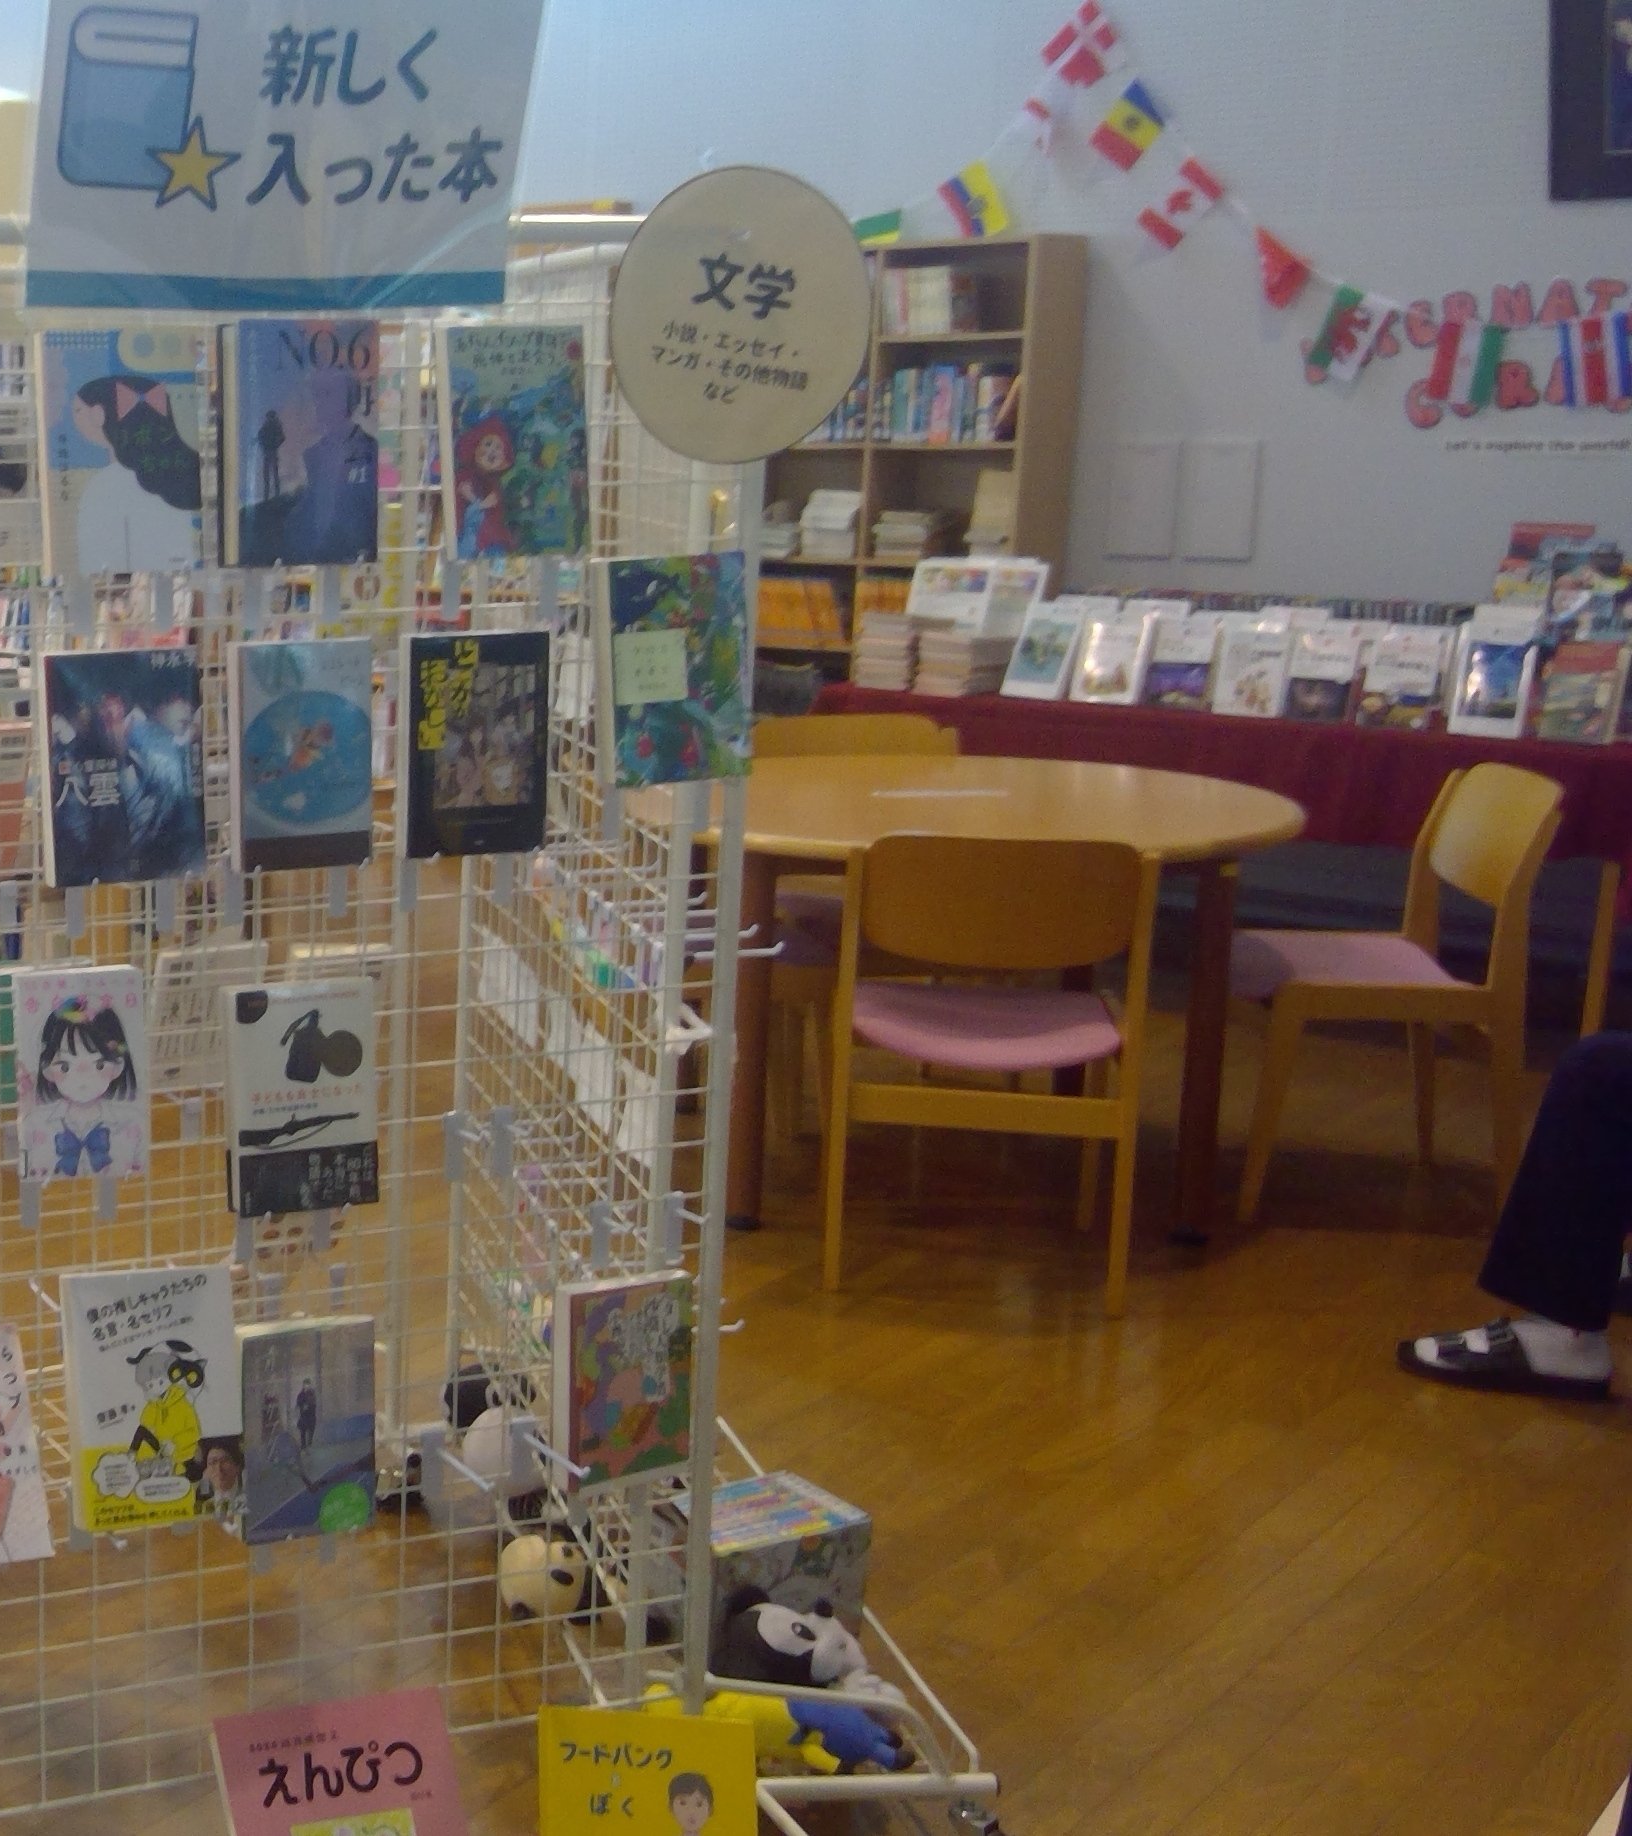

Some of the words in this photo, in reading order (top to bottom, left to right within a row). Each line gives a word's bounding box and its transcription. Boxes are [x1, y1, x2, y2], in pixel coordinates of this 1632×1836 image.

[261, 23, 439, 107] 新しく
[245, 125, 505, 206] 入った本
[691, 252, 797, 320] 文学
[277, 327, 372, 371] NO.6
[662, 320, 799, 359] 小説・エッセイ・
[652, 345, 809, 391] マンガ・その他物語
[702, 380, 739, 405] など
[55, 771, 121, 808] 八雲
[258, 1739, 423, 1808] えんぴつ
[559, 1742, 673, 1769] フードバンク
[589, 1791, 635, 1818] ぼく
